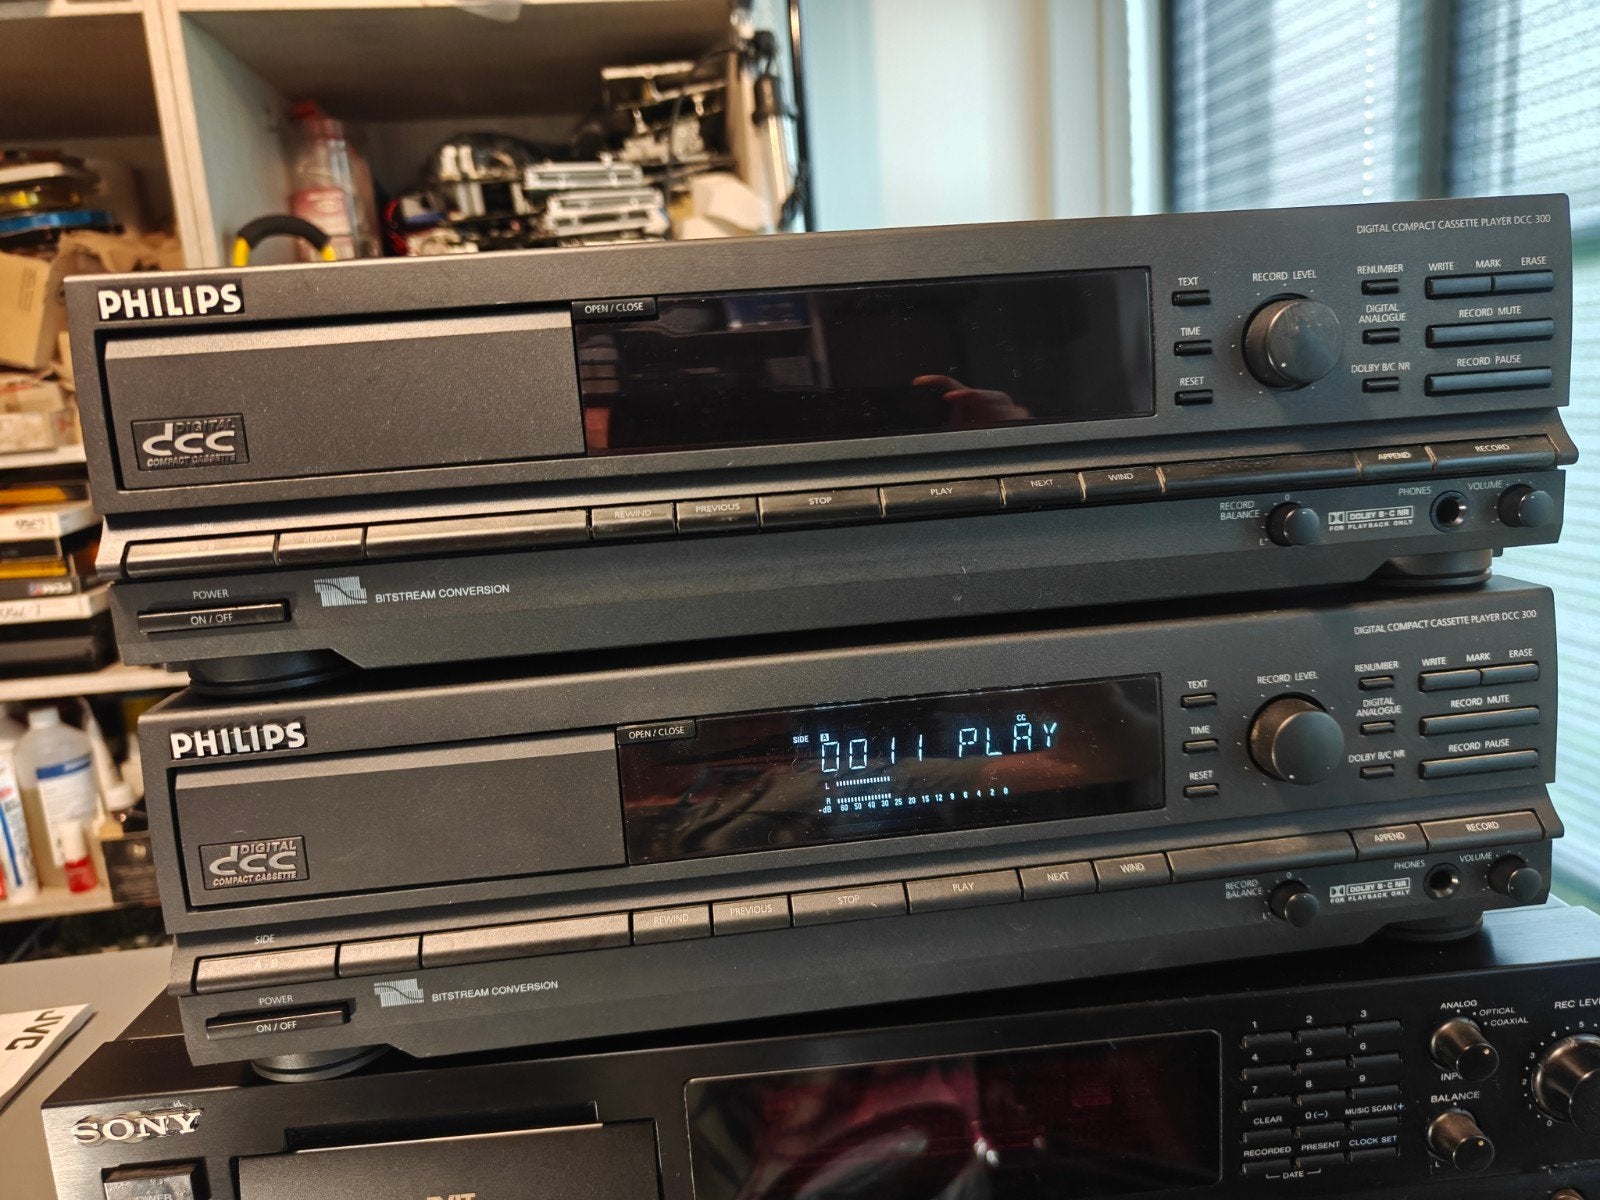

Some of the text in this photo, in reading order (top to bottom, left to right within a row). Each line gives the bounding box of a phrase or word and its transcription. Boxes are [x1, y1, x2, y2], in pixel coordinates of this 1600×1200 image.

[1356, 214, 1551, 235] DIGITAL COMPACT CASSETTE PLAYER DCC 300
[1475, 260, 1502, 269] MARK
[1521, 256, 1547, 266] ERASE
[1357, 264, 1404, 275] RENUMBER
[1428, 262, 1454, 272] WRITE
[1178, 276, 1200, 287] TEXT
[1252, 270, 1317, 282] RECORD LEVEL
[98, 283, 241, 320] PHILIPS
[584, 302, 644, 314] OPEN CLOSE
[1366, 304, 1399, 313] DIGITAL
[1459, 306, 1521, 318] RECORD MUTE
[1359, 313, 1407, 323] ANALOGUE
[1180, 326, 1200, 336] TIME
[1456, 354, 1521, 368] RECORD PAUSE
[1351, 361, 1410, 374] DOLBY B/C NR
[1180, 376, 1205, 387] RESET
[1474, 444, 1509, 452] RECORD
[1378, 451, 1412, 460] APPEND
[147, 456, 189, 468] COMPACT
[1108, 472, 1135, 482] WIND
[1030, 479, 1054, 489] NEXT
[1467, 480, 1502, 491] VOLUME
[930, 487, 954, 497] PLAY
[1398, 486, 1432, 496] PHONES
[808, 496, 832, 506] STOP
[1220, 500, 1255, 511] RECORD
[696, 502, 740, 514] PREVIOUS
[614, 509, 652, 519] REWIND
[1220, 510, 1260, 521] BALANCE
[1350, 511, 1376, 521] DOLBY
[1329, 519, 1414, 532] FOR PLAYBACK ONLY
[192, 588, 230, 600] POWER
[375, 584, 510, 603] BITSTREAM CONVERSION
[190, 613, 234, 626] ON OFF
[1354, 610, 1537, 635] DIGITAL COMPACT CASSETTE PLAYER DCC 300
[1466, 652, 1491, 662] MARK
[1508, 648, 1534, 658] ERASE
[1354, 660, 1399, 672] RENUMBER
[1421, 656, 1446, 667] WRITE
[1256, 670, 1318, 684] RECORD LEVEL
[1187, 680, 1210, 690] TEXT
[1363, 698, 1394, 708] DIGITAL
[1450, 694, 1510, 709] RECORD MUTE
[1356, 706, 1402, 717] ANALOGUE
[628, 726, 685, 740] OPEN CLOSE
[1189, 725, 1210, 735] TIME
[170, 722, 306, 760] PHILIPS
[792, 734, 810, 744] SIDE
[958, 722, 1058, 758] PLAY
[1448, 738, 1510, 753] RECORD PAUSE
[1348, 750, 1406, 763] DOLBY B/C NR
[1189, 770, 1214, 780] RESET
[824, 782, 830, 790] L
[868, 801, 876, 809] 40
[880, 800, 889, 808] 30
[894, 798, 903, 806] 25
[921, 796, 930, 804] 15
[935, 794, 944, 802] 12
[1466, 821, 1499, 832] RECORD
[1374, 832, 1406, 842] APPEND
[241, 840, 297, 855] DIGITAL
[1459, 852, 1492, 862] VOLUME
[1120, 862, 1146, 874] WIND
[1394, 860, 1426, 870] PHONES
[213, 871, 297, 886] COMPACT CASSETTE
[1046, 871, 1071, 882] NEXT
[952, 882, 975, 892] PLAY
[1224, 879, 1258, 890] RECORD
[1350, 884, 1376, 894] DOLBY
[1225, 887, 1264, 900] BALANCE
[1348, 892, 1388, 902] PLAYBACK
[1390, 889, 1410, 898] ONLY
[838, 894, 860, 905] STOP
[730, 904, 774, 916] PREVIOUS
[653, 914, 689, 926] REWIND
[254, 934, 276, 944] SIDE
[431, 980, 559, 1002] BITSTREAM CONVERSION
[258, 995, 294, 1006] POWER
[1440, 1000, 1478, 1010] ANALOG
[1554, 998, 1600, 1010] REC LEV
[1360, 1010, 1367, 1018] 3
[1479, 1006, 1516, 1017] OPTICAL
[1252, 1020, 1258, 1028] 1
[1306, 1015, 1313, 1024] 2
[1490, 1016, 1529, 1027] COAXIAL
[5, 1009, 66, 1050] JVC
[256, 1020, 298, 1034] ON OFF
[1551, 1030, 1557, 1038] 4
[1360, 1042, 1366, 1050] 6
[1252, 1053, 1258, 1061] 4
[1306, 1048, 1312, 1056] 5
[1530, 1052, 1536, 1060] 3
[1360, 1074, 1366, 1082] 9
[1522, 1078, 1528, 1086] 2
[1306, 1080, 1312, 1088] 8
[1252, 1086, 1258, 1094] 7
[1430, 1091, 1480, 1104] BALANCE
[1344, 1104, 1393, 1116] MUSIC SCAN
[1253, 1116, 1283, 1126] CLEAR
[70, 1112, 202, 1144] SONY
[1301, 1140, 1341, 1152] PRESENT
[1349, 1134, 1398, 1148] CLOCK SET
[1244, 1146, 1292, 1158] RECORDED
[1282, 1171, 1304, 1180] DATE
